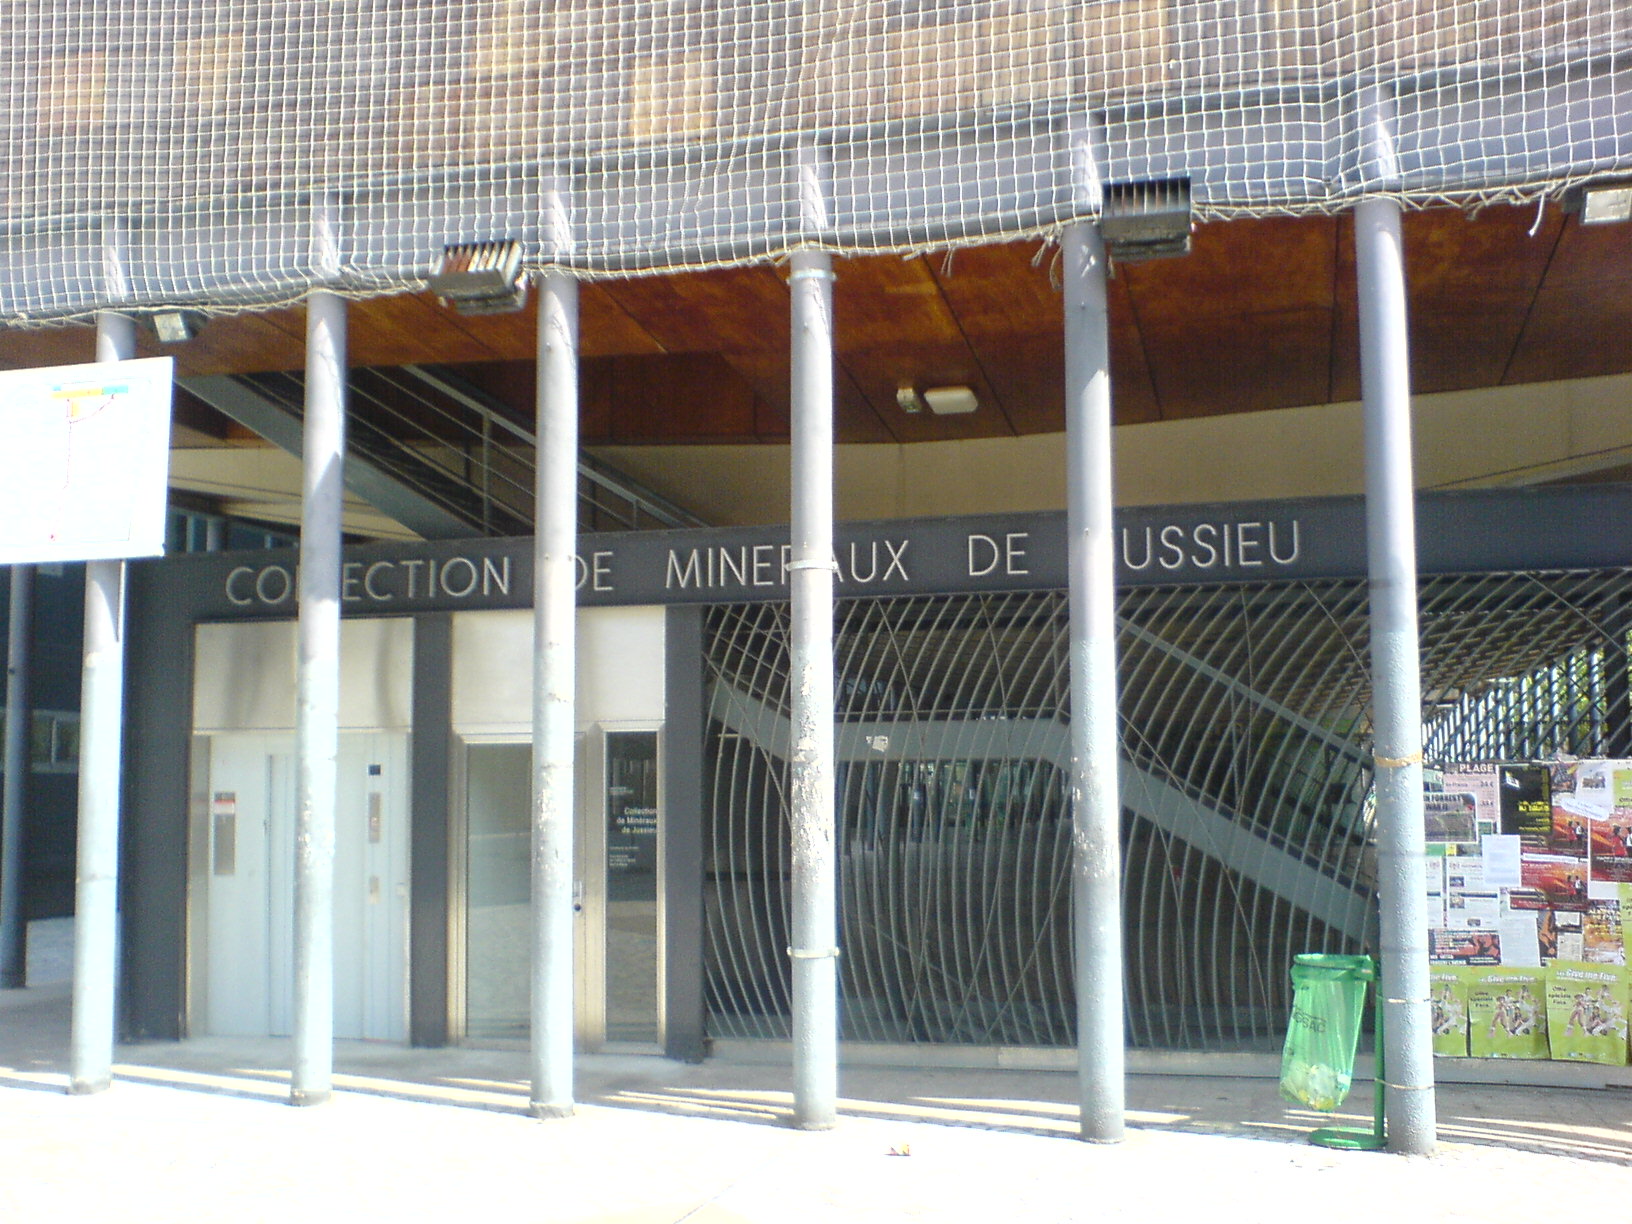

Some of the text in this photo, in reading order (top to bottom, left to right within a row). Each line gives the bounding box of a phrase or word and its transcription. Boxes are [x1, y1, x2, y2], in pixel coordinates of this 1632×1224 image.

[226, 555, 511, 606] COECTION
[968, 532, 1029, 577] DE
[1122, 519, 1300, 571] USSIEU
[1459, 763, 1494, 773] PLAGE
